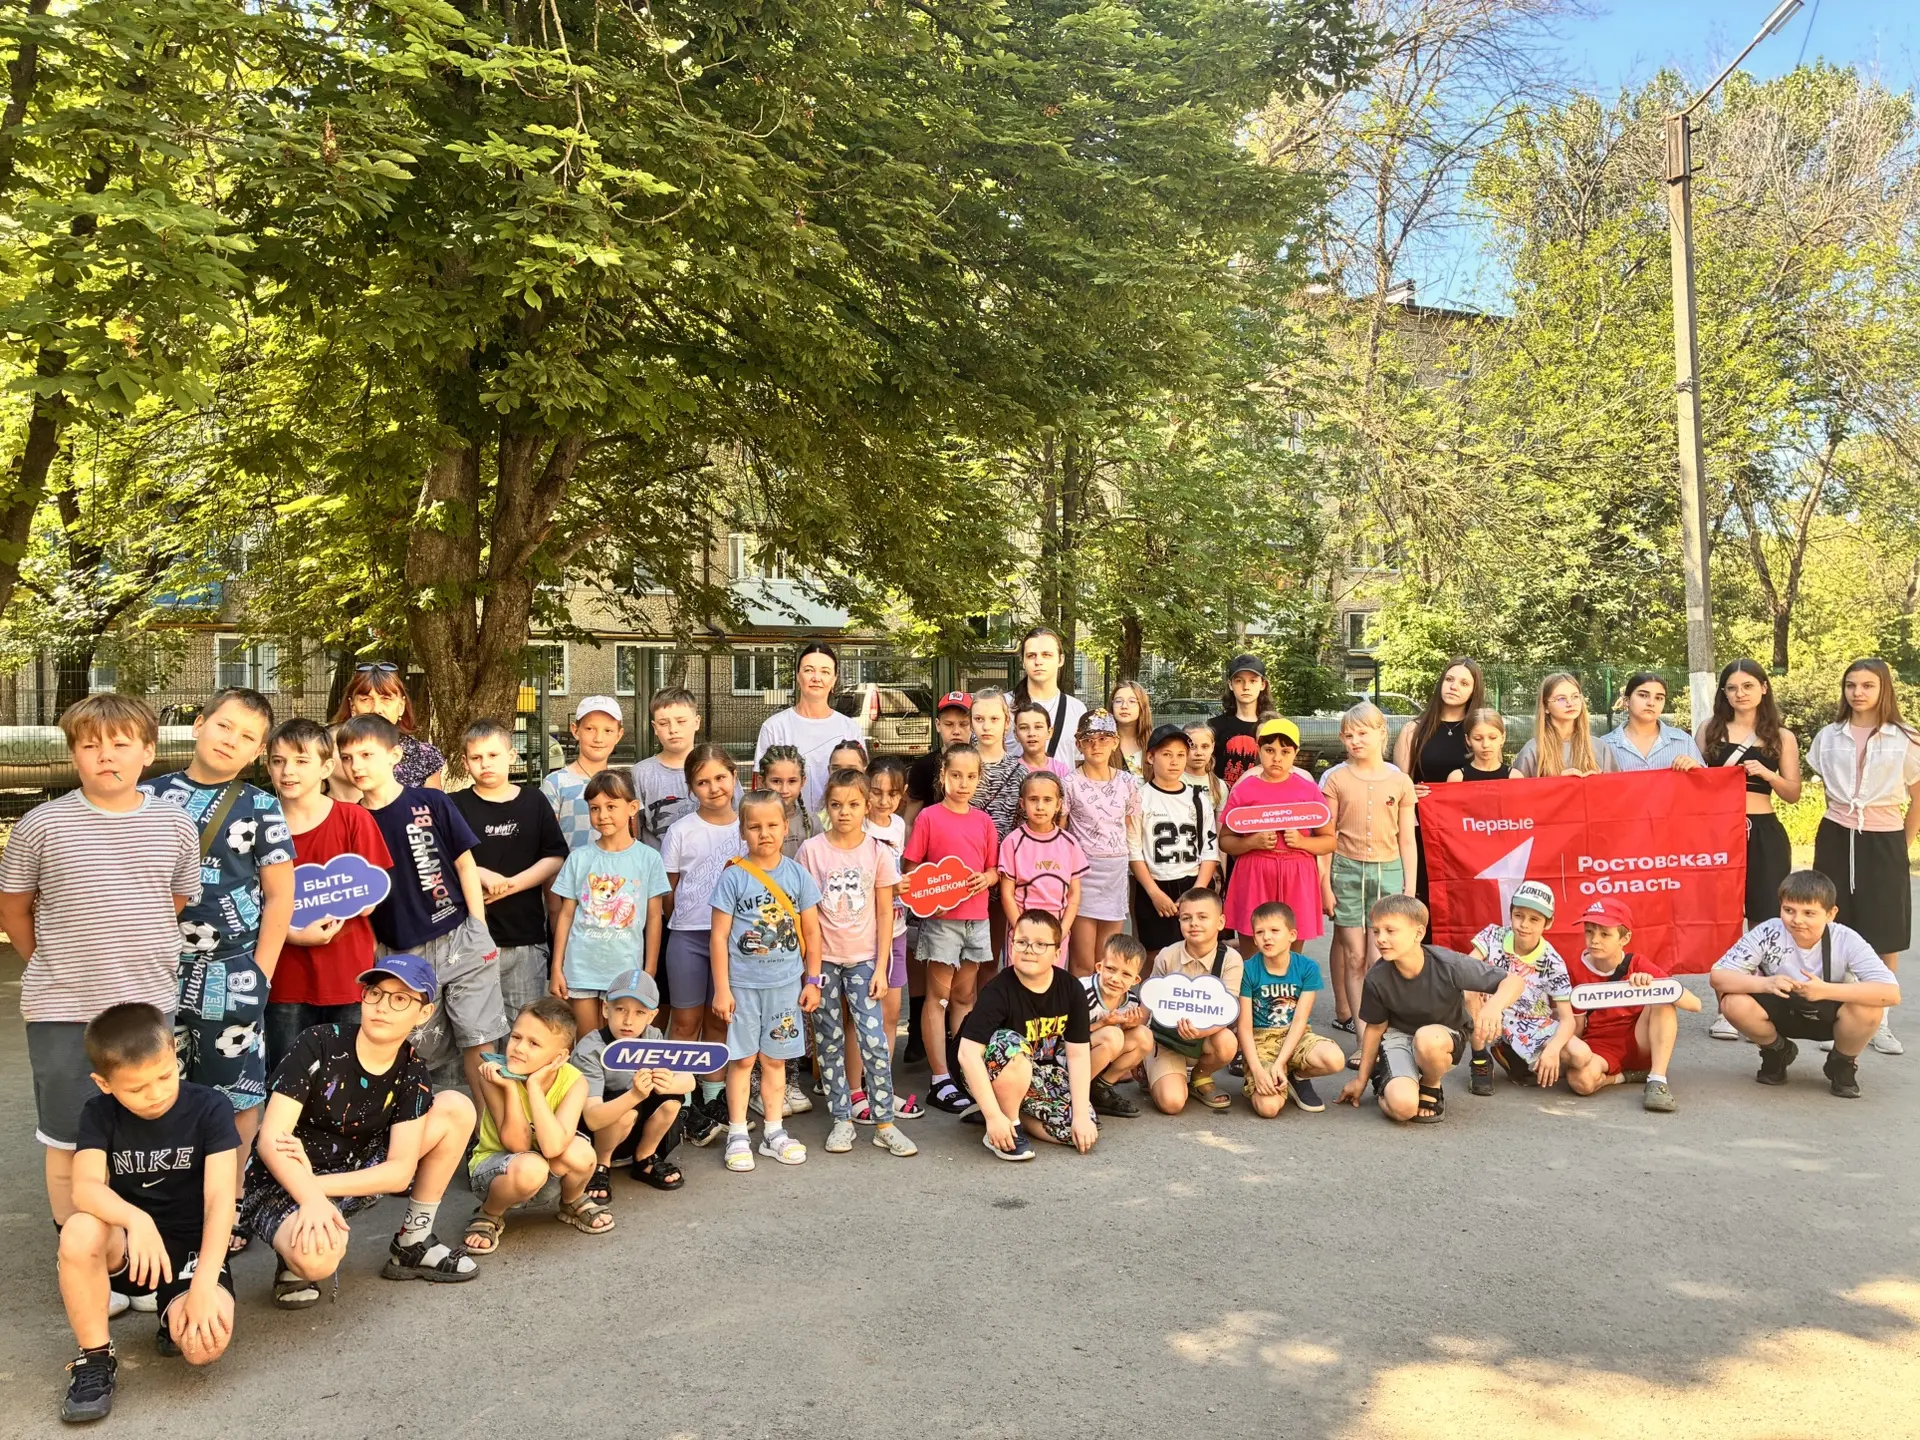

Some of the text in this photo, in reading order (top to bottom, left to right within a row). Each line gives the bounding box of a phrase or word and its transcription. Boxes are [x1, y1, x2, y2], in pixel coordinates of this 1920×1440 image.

[410, 804, 433, 828] BE
[1242, 813, 1323, 826] СПРАВЕДЛИВОСТЬ
[1262, 809, 1293, 818] ДОБРО
[1462, 817, 1535, 836] Первые
[1153, 822, 1197, 864] 23
[1577, 852, 1729, 873] Ростовская
[303, 873, 353, 892] БЫТЬ
[911, 878, 969, 899] ЧЕЛОВЕКОМ!
[927, 873, 952, 885] БЫТЬ
[1579, 876, 1682, 895] область
[1520, 885, 1552, 905] LONDON
[202, 961, 227, 1022] TEAM
[226, 969, 258, 1012] 78
[1173, 987, 1212, 1000] БЫТЬ
[1260, 983, 1298, 998] SURF
[1578, 986, 1675, 1002] ПАТРИОТИЗМ
[1158, 999, 1224, 1016] ПЕРВЫМ!
[616, 1048, 711, 1067] МЕЧТА
[112, 1146, 194, 1175] NIKE
